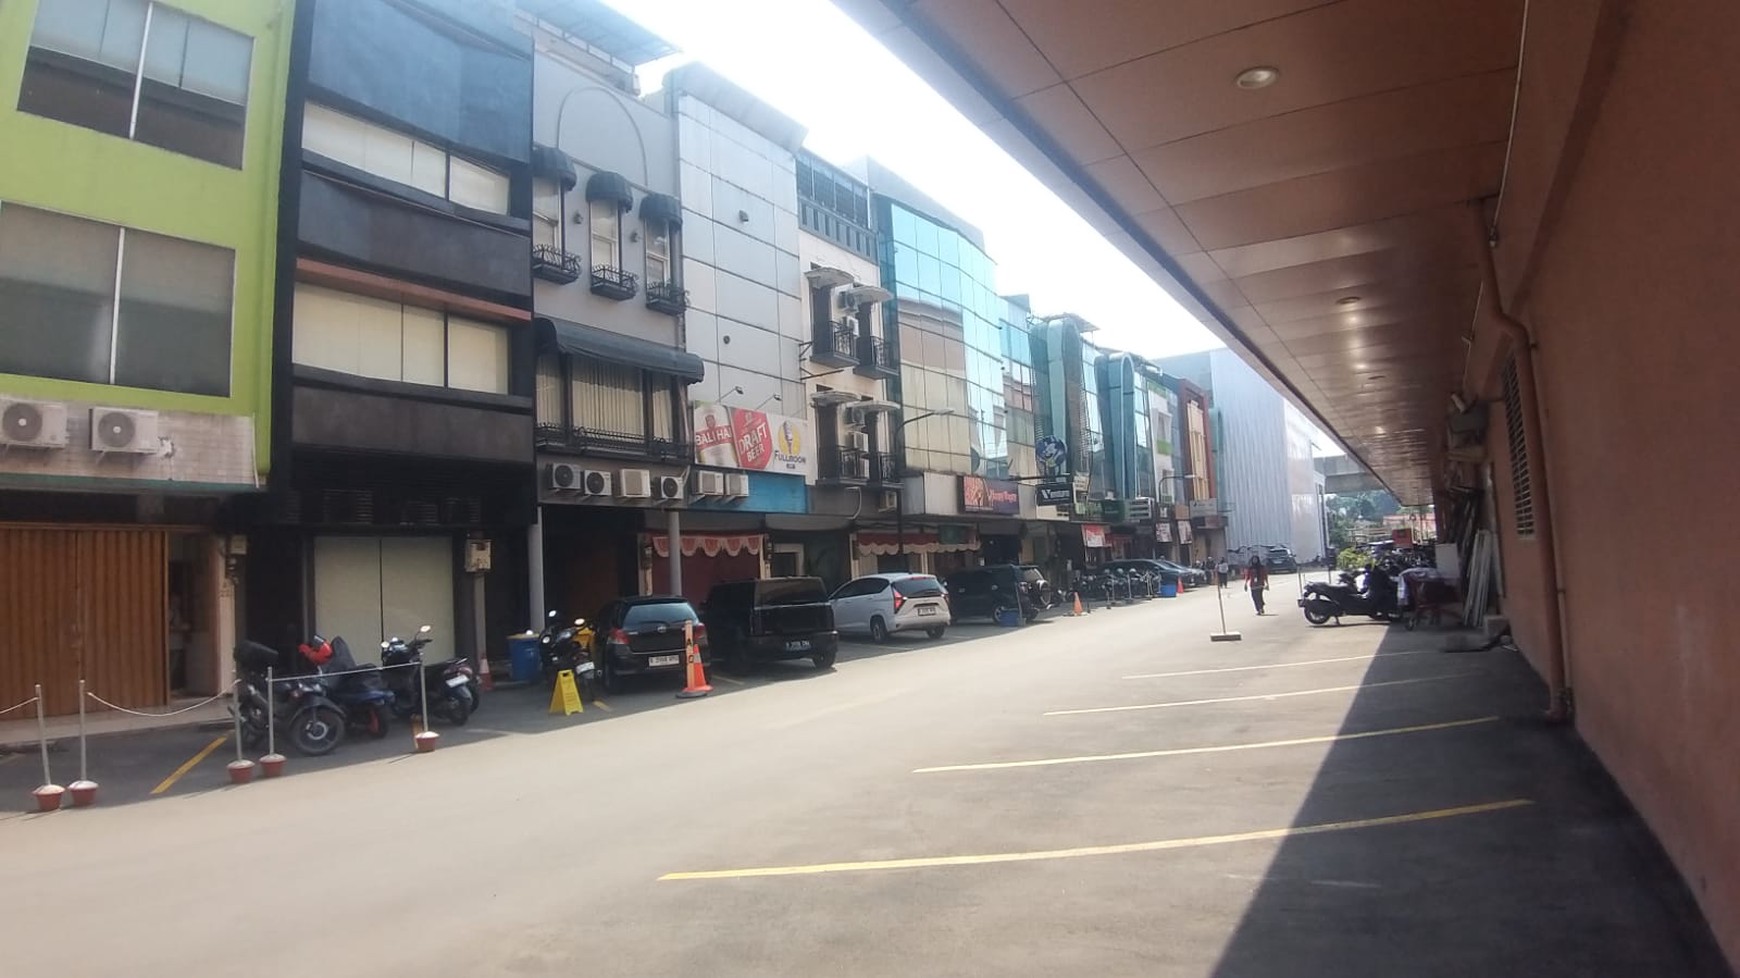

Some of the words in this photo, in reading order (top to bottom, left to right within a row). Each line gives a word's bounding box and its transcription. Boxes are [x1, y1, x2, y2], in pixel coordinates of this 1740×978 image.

[695, 431, 717, 446] BALI
[738, 423, 767, 455] DRAFT
[747, 443, 765, 462] BEER
